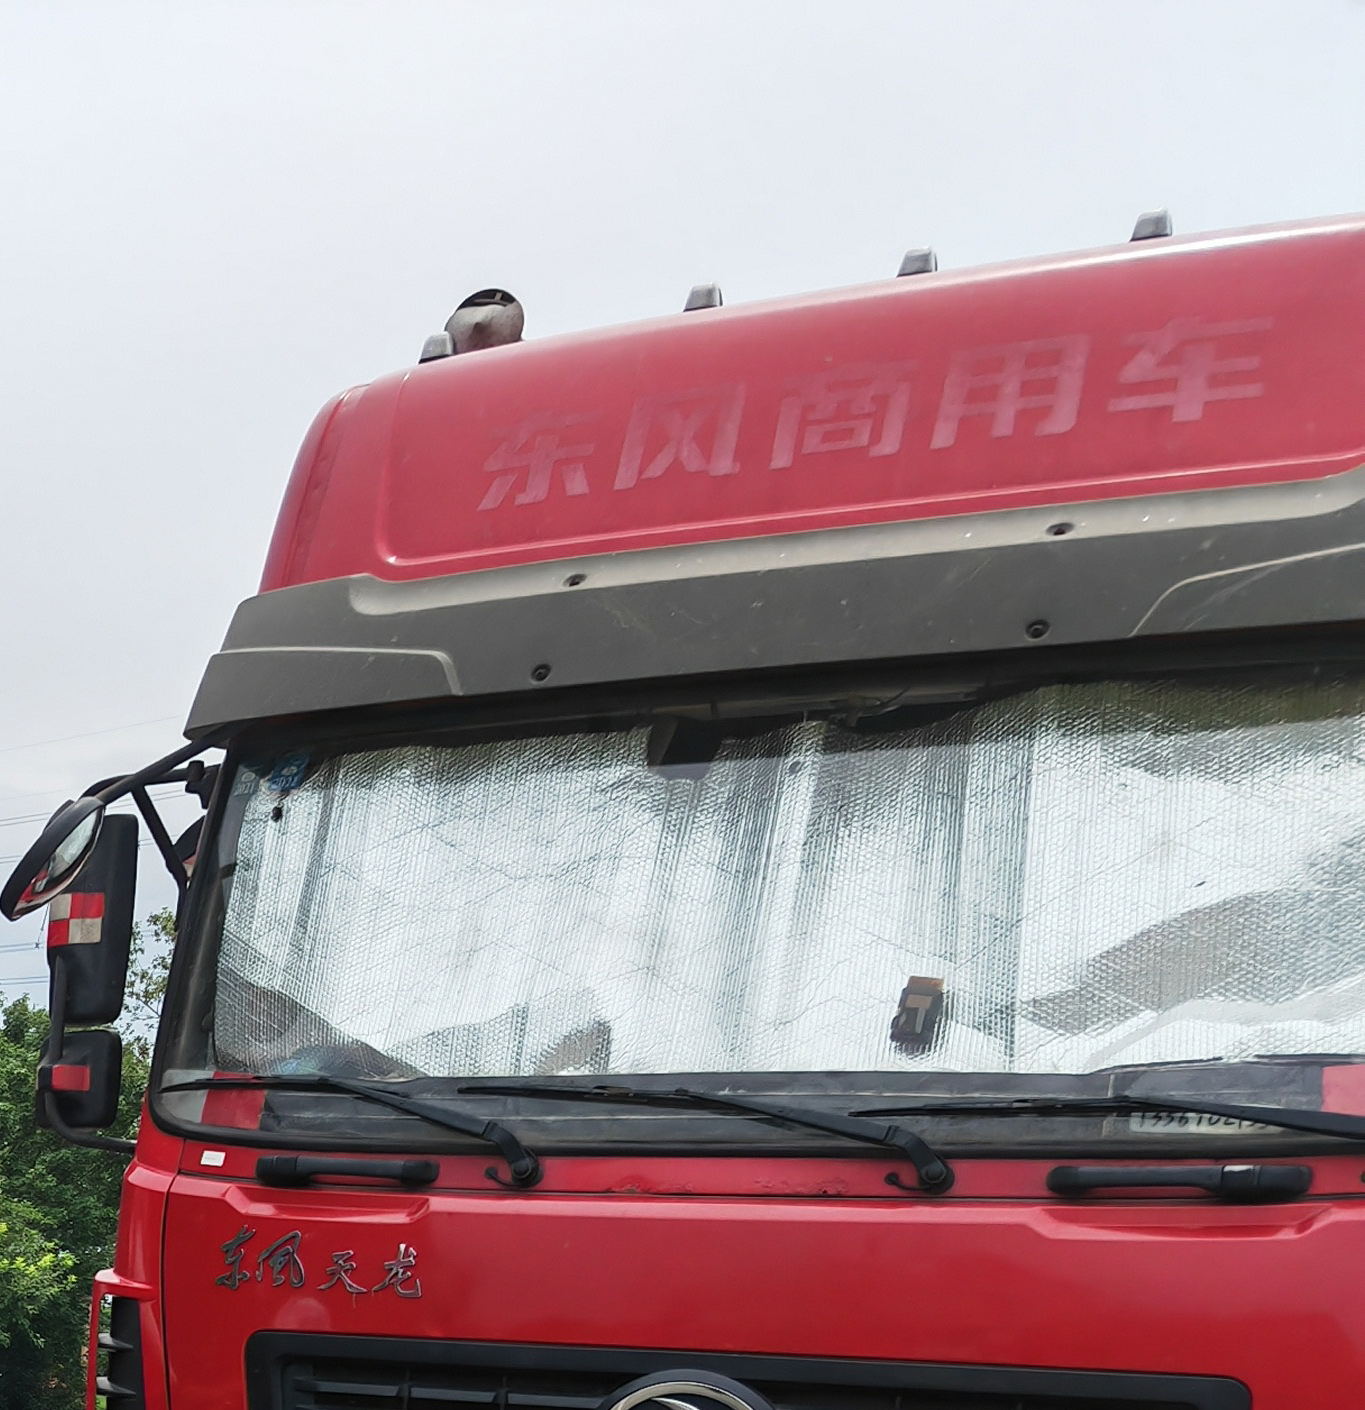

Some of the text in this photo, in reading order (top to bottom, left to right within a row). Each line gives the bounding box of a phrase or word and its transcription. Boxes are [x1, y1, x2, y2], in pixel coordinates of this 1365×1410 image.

[478, 316, 1274, 511] 东风商用车
[214, 1225, 423, 1298] 东风天龙
